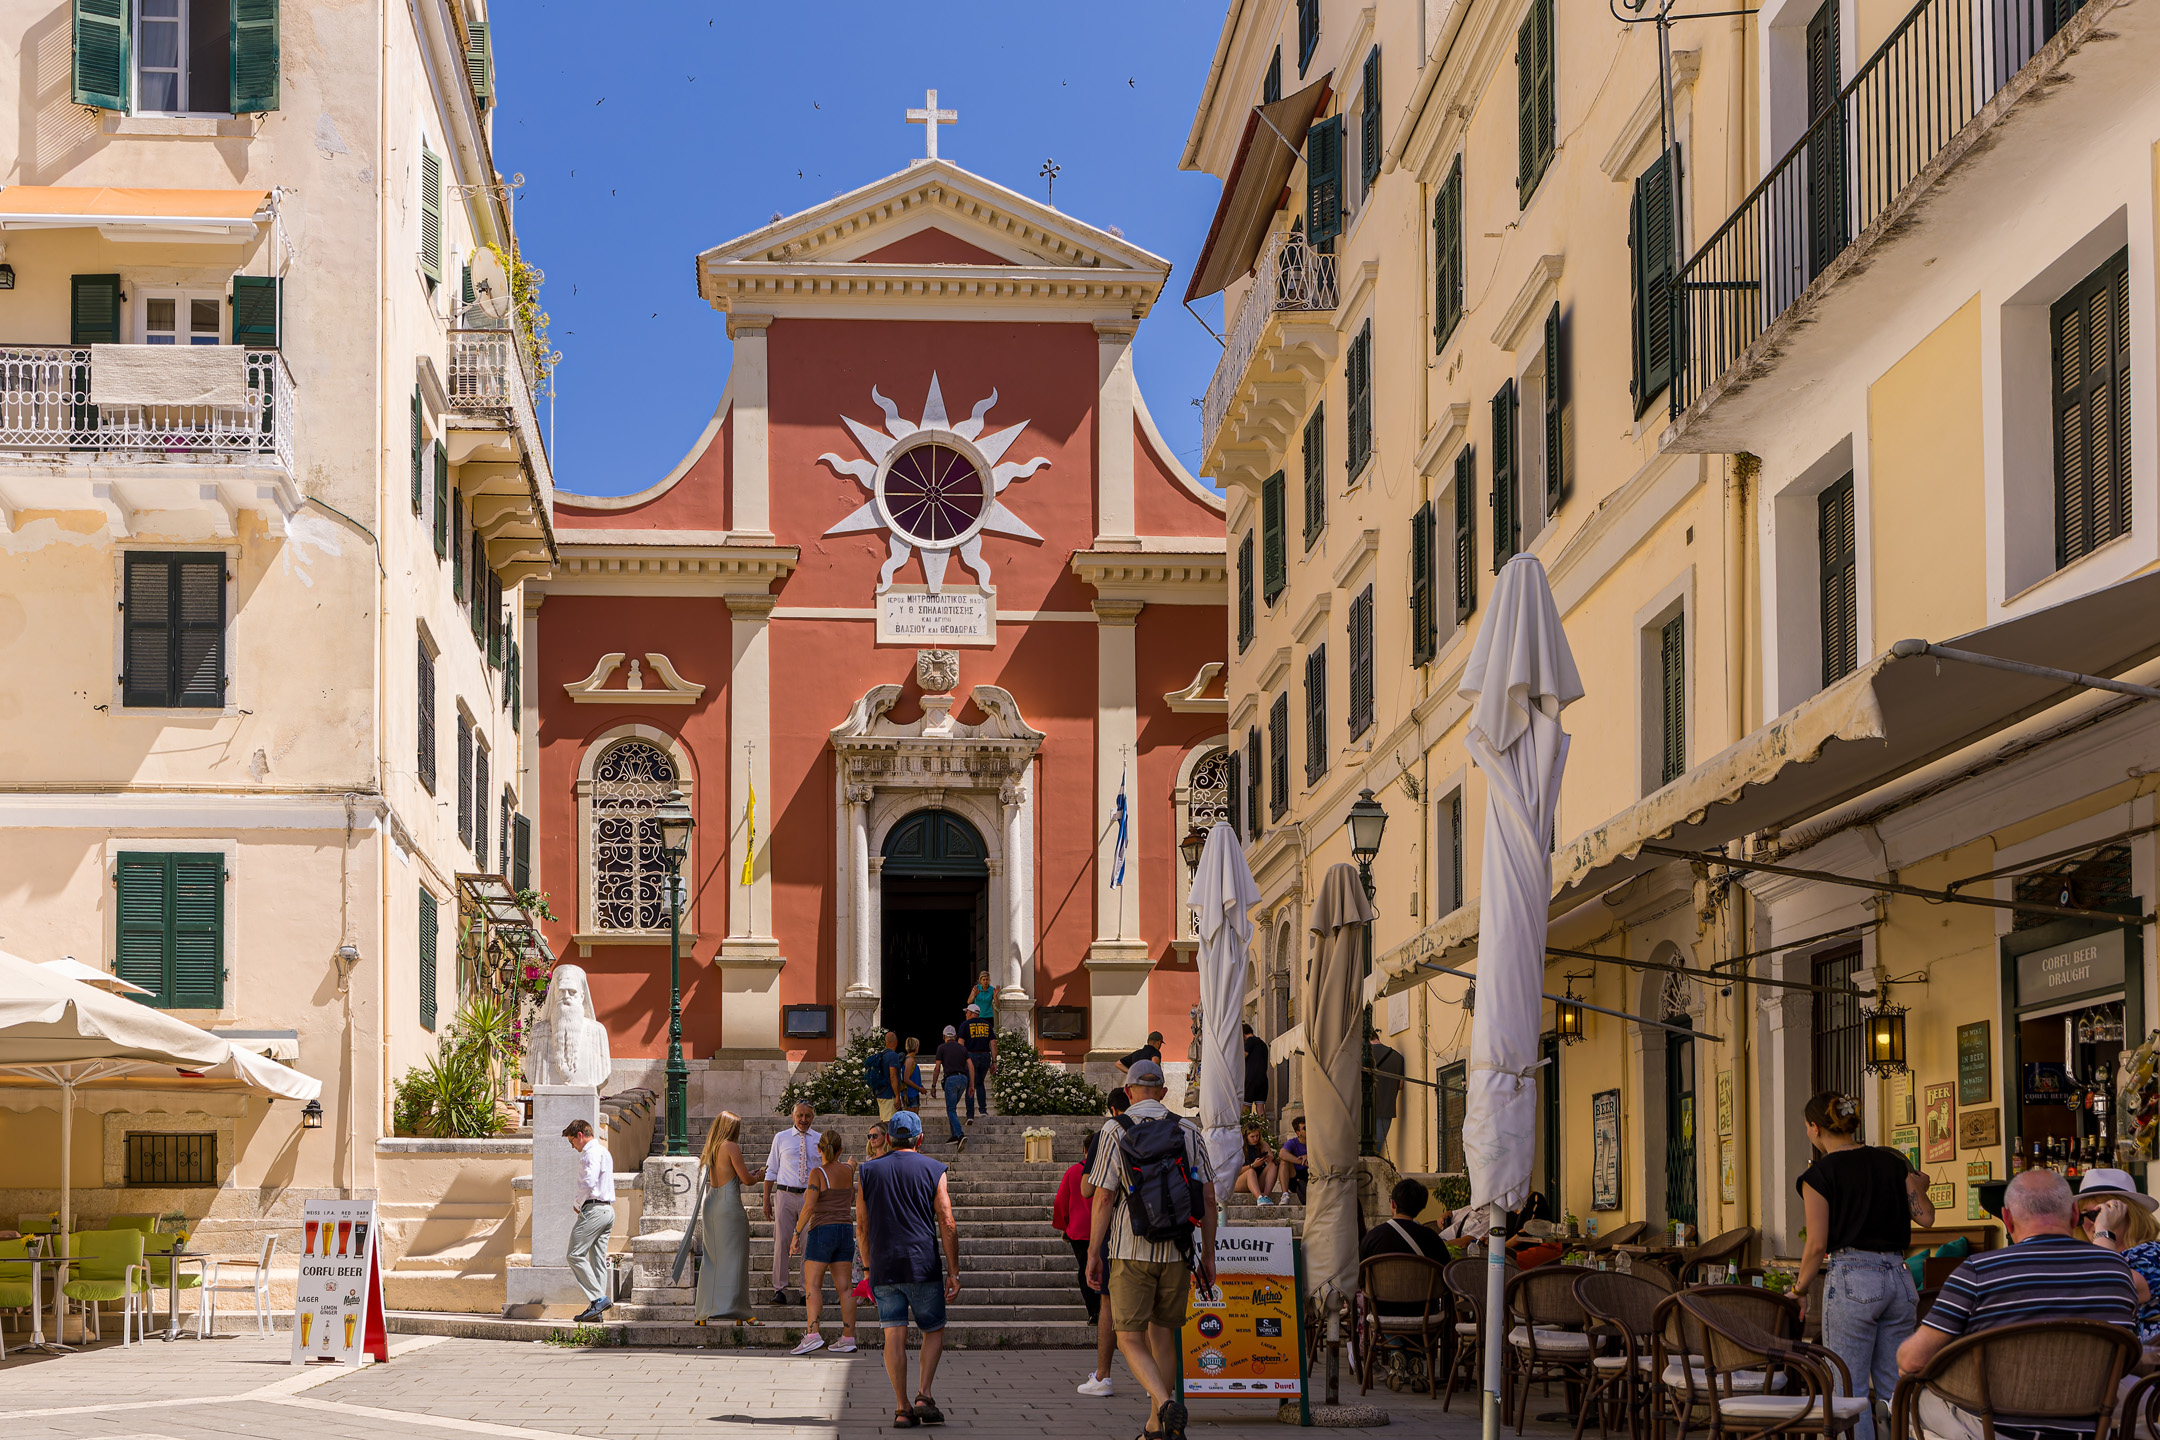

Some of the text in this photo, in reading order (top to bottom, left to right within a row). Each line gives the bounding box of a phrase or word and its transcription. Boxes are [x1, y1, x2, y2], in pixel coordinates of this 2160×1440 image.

[896, 624, 926, 633] ΒΛΑΣΙΟΥ
[940, 625, 978, 634] ΘΕΟΔΩΡΑΣ
[2042, 946, 2097, 971] CORFU BEER
[2049, 965, 2091, 987] DRAUGHT
[970, 1026, 990, 1035] FIRE
[1927, 1087, 1950, 1106] BEER
[1596, 1101, 1614, 1116] BEER
[1968, 1165, 1988, 1176] BEER
[1931, 1191, 1951, 1202] BEER
[302, 1266, 362, 1276] CORFU BEER
[1252, 1289, 1283, 1306] Mythos
[1252, 1354, 1281, 1364] Septem
